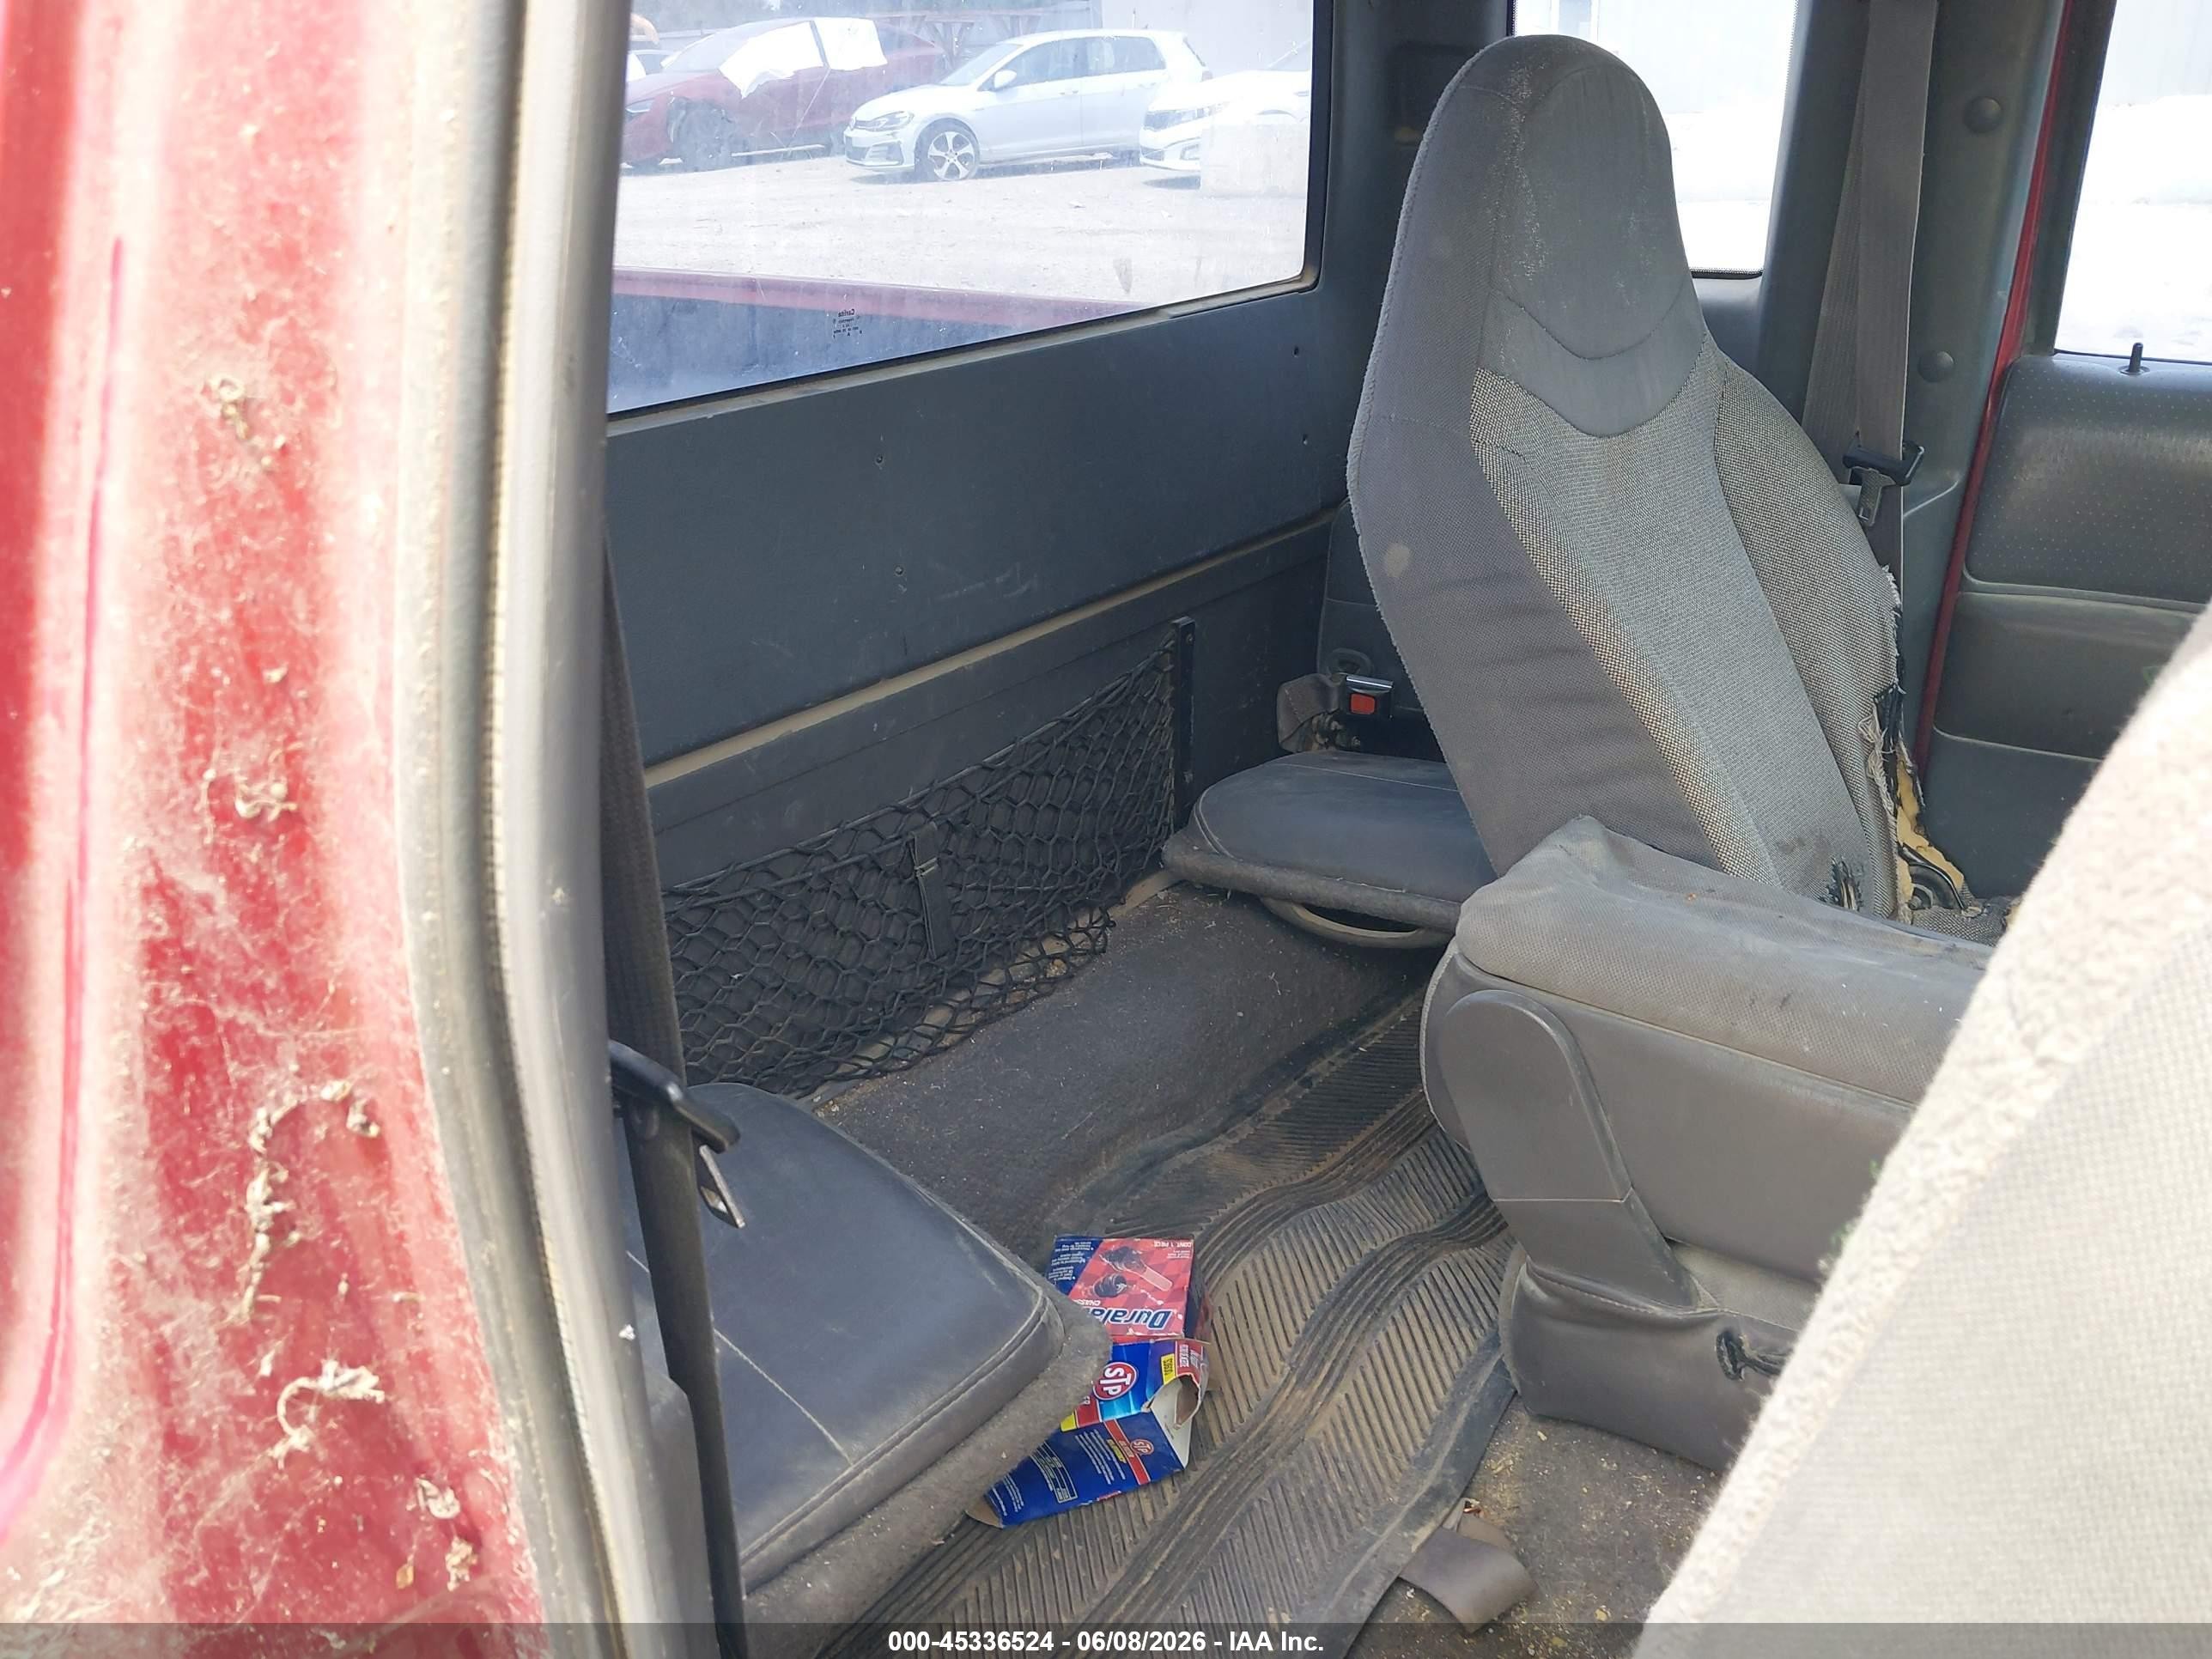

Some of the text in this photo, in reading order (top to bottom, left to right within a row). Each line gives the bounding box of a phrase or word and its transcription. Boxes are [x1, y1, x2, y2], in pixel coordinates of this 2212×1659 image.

[1089, 1308, 1173, 1330] Durala
[1099, 1366, 1132, 1396] STP
[1133, 1440, 1152, 1453] STP
